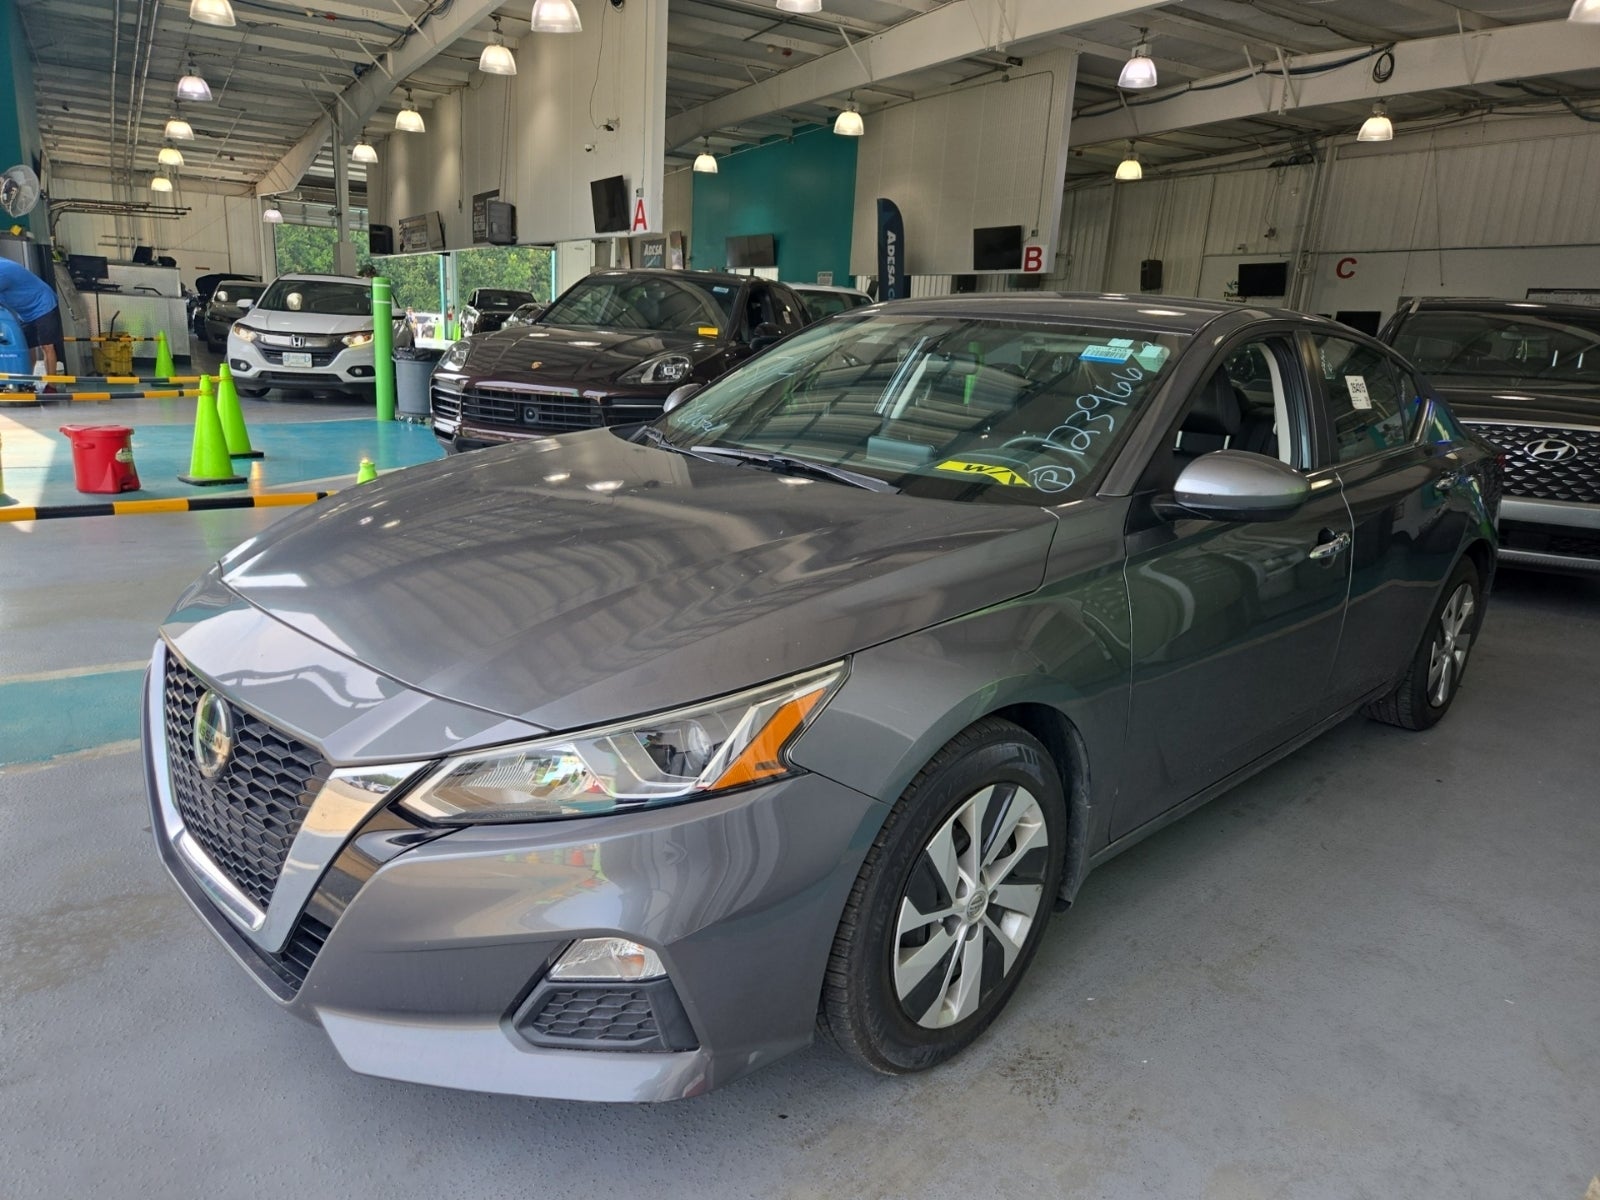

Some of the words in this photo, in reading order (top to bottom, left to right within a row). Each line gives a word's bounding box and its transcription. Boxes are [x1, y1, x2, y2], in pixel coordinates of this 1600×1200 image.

[633, 199, 648, 232] A
[887, 230, 897, 285] ADESA
[1024, 247, 1043, 272] B
[1336, 257, 1357, 279] C
